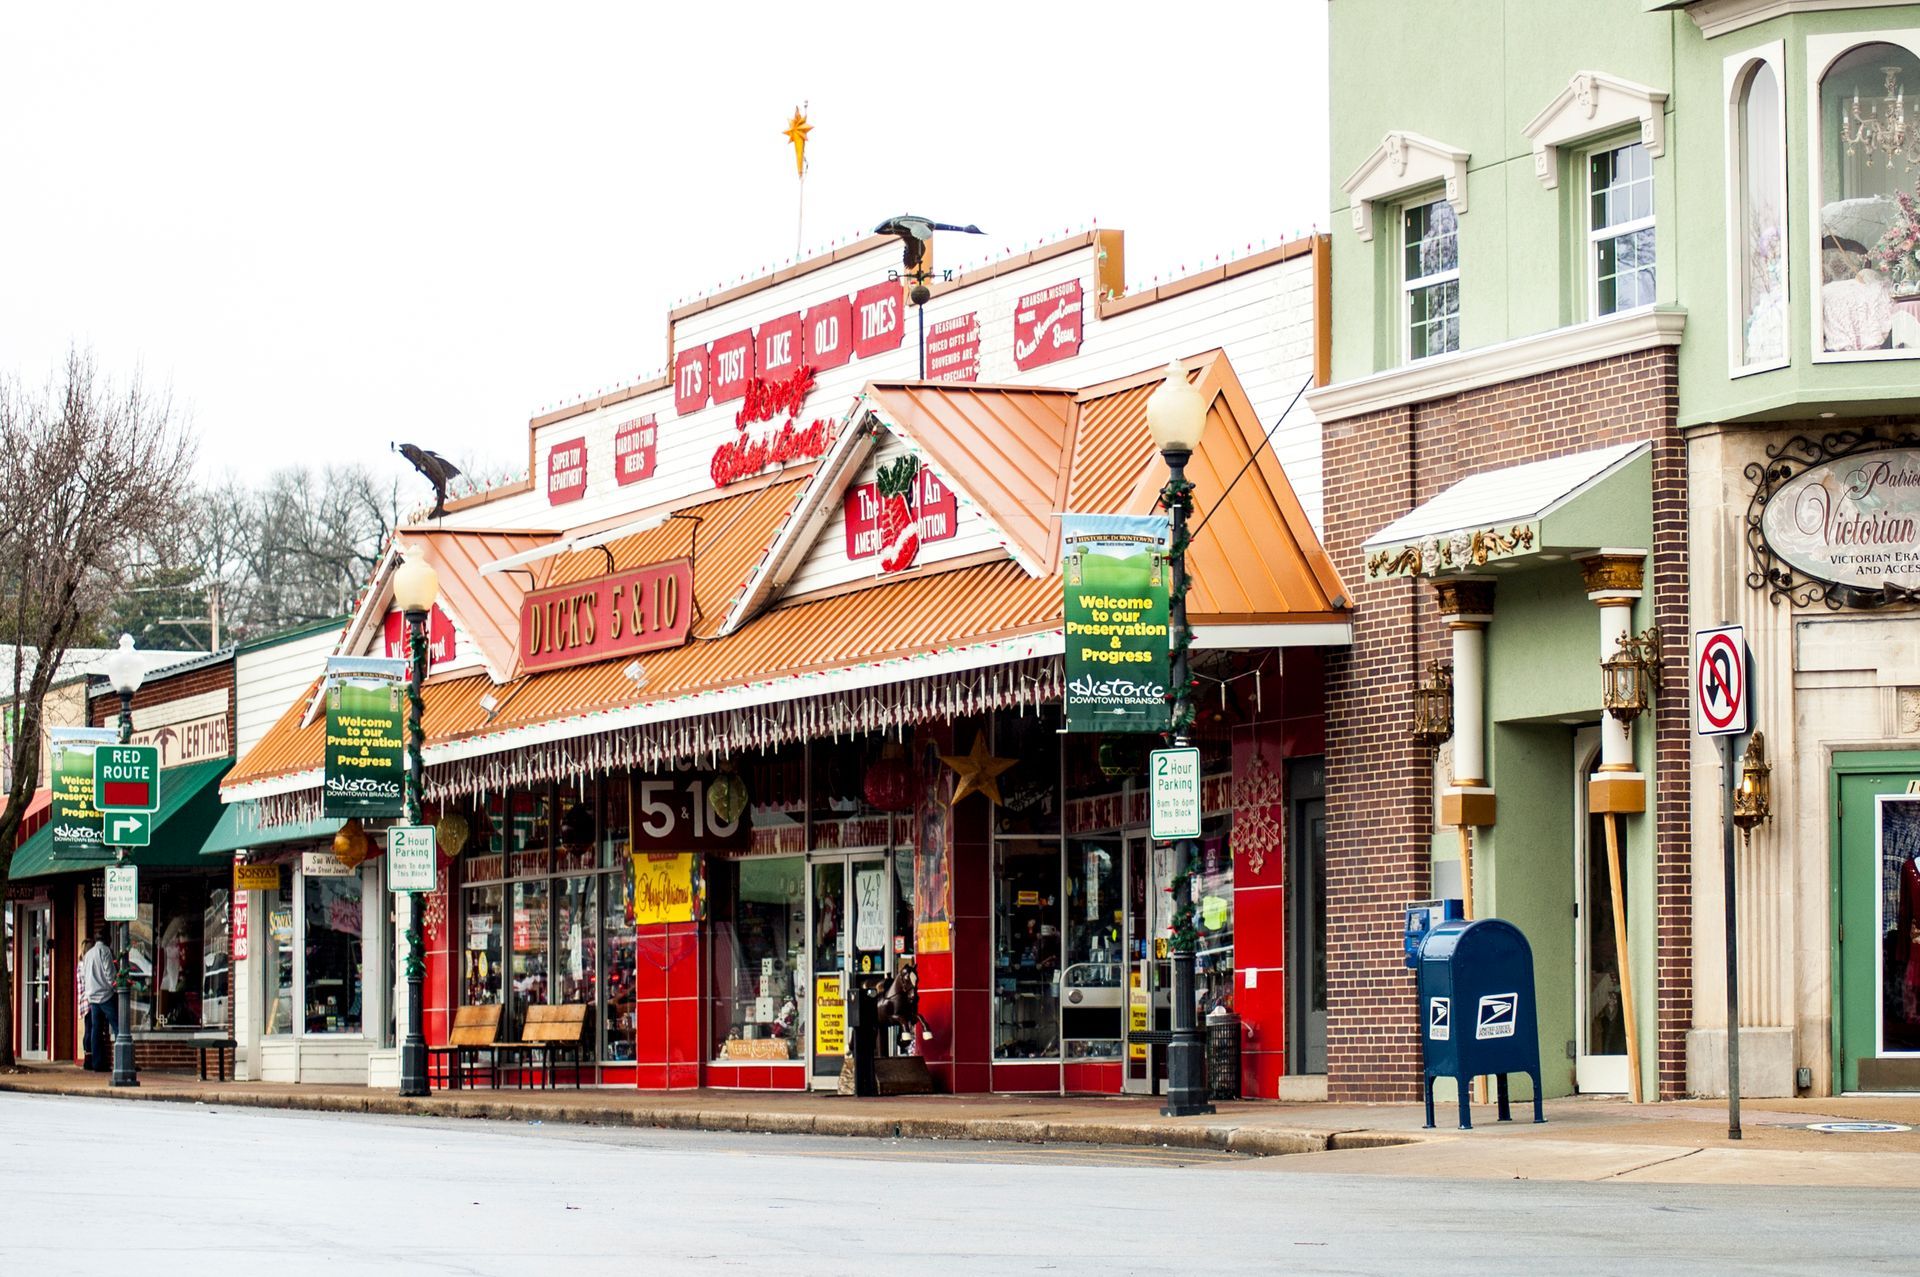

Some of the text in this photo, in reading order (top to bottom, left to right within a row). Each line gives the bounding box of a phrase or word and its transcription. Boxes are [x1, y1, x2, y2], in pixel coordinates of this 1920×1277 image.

[935, 314, 970, 334] REASONABLY
[680, 296, 896, 399] IT'S JUST LIKE OLD TIMES
[929, 339, 948, 354] PRICED
[949, 333, 966, 351] GIFTS
[931, 348, 973, 371] SOUVENIRS ARE
[616, 427, 654, 457] HARD TO FIND
[552, 447, 581, 473] SUPER TOY
[624, 450, 645, 475] NEEDS
[549, 466, 583, 493] DEPARTMENT
[858, 489, 879, 521] The
[923, 472, 941, 505] An
[1794, 482, 1916, 546] Victorian
[1830, 551, 1920, 565] VICTORIAN ERA
[1856, 565, 1881, 576] AND
[1079, 595, 1153, 610] Welcome
[530, 573, 677, 655] DICK'S 5 & 10
[1091, 609, 1140, 623] to our
[1066, 622, 1167, 636] Preservation
[1110, 635, 1122, 649] &
[1081, 648, 1152, 664] Progress
[1069, 673, 1165, 697] Historic
[1069, 696, 1165, 705] DOWNTOWN BRANSON
[337, 717, 392, 729] Welcome
[181, 718, 228, 760] LEATHER
[346, 727, 384, 738] to our
[327, 735, 402, 748] Preservation
[112, 750, 141, 764] RED
[360, 746, 370, 757] &
[337, 756, 392, 768] Progress
[1158, 756, 1192, 776] 2 Hour
[103, 765, 150, 779] ROUTE
[60, 776, 94, 786] Welco
[326, 774, 400, 792] Historic
[1158, 778, 1192, 792] Parking
[68, 784, 80, 794] to
[326, 790, 368, 798] DOWNTOWN
[1172, 798, 1179, 807] To
[1160, 808, 1192, 818] This Block
[395, 831, 429, 846] 2 Hour
[395, 848, 429, 859] Parking
[109, 870, 117, 883] 2
[109, 883, 132, 893] Parking
[824, 982, 840, 995] Merry
